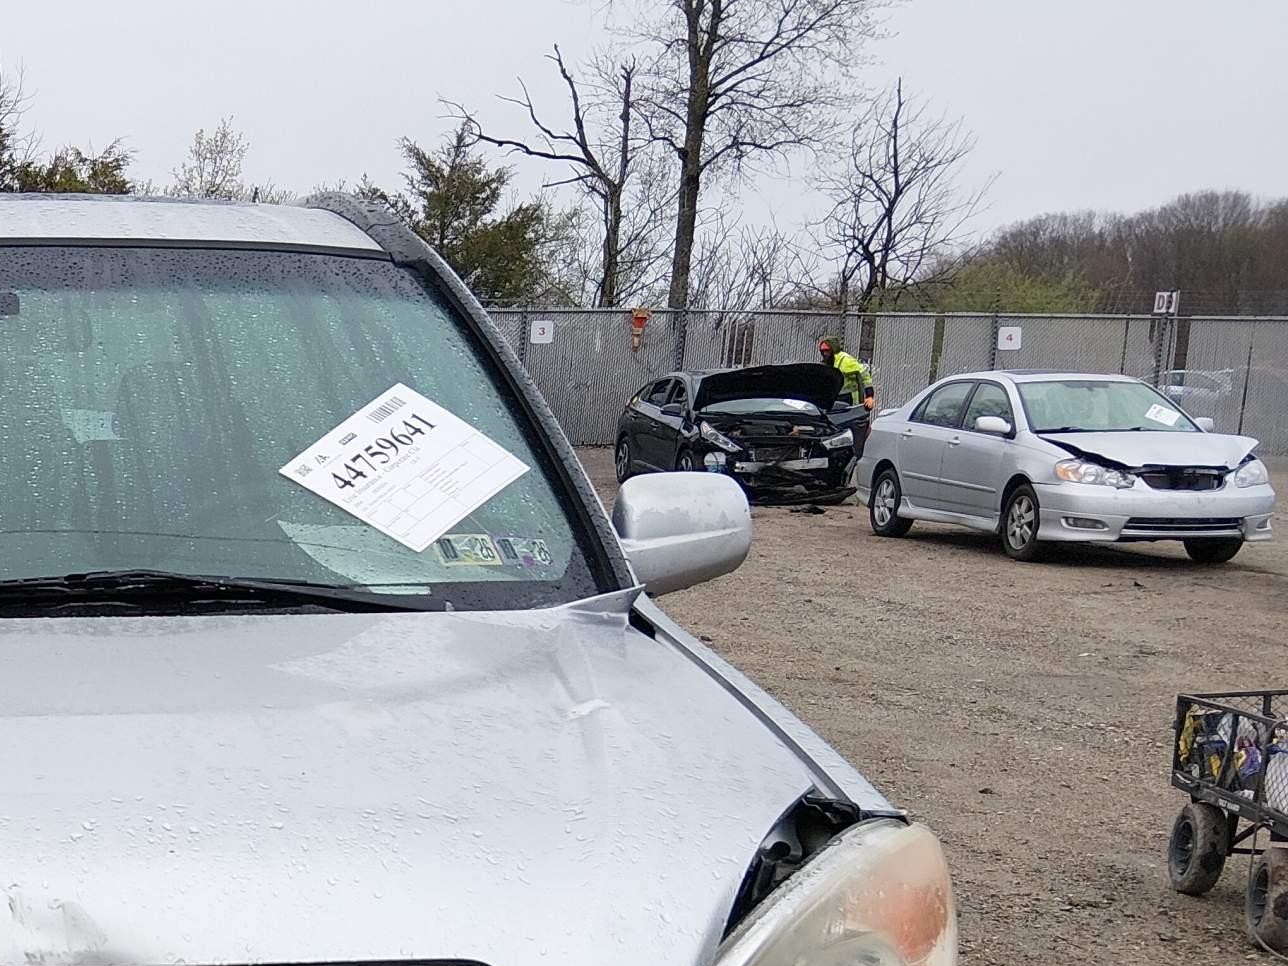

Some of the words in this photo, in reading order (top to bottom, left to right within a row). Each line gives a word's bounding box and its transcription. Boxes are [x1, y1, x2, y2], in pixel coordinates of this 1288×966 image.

[538, 327, 546, 336] 3
[1005, 333, 1013, 342] 4
[331, 413, 437, 490] 44759641
